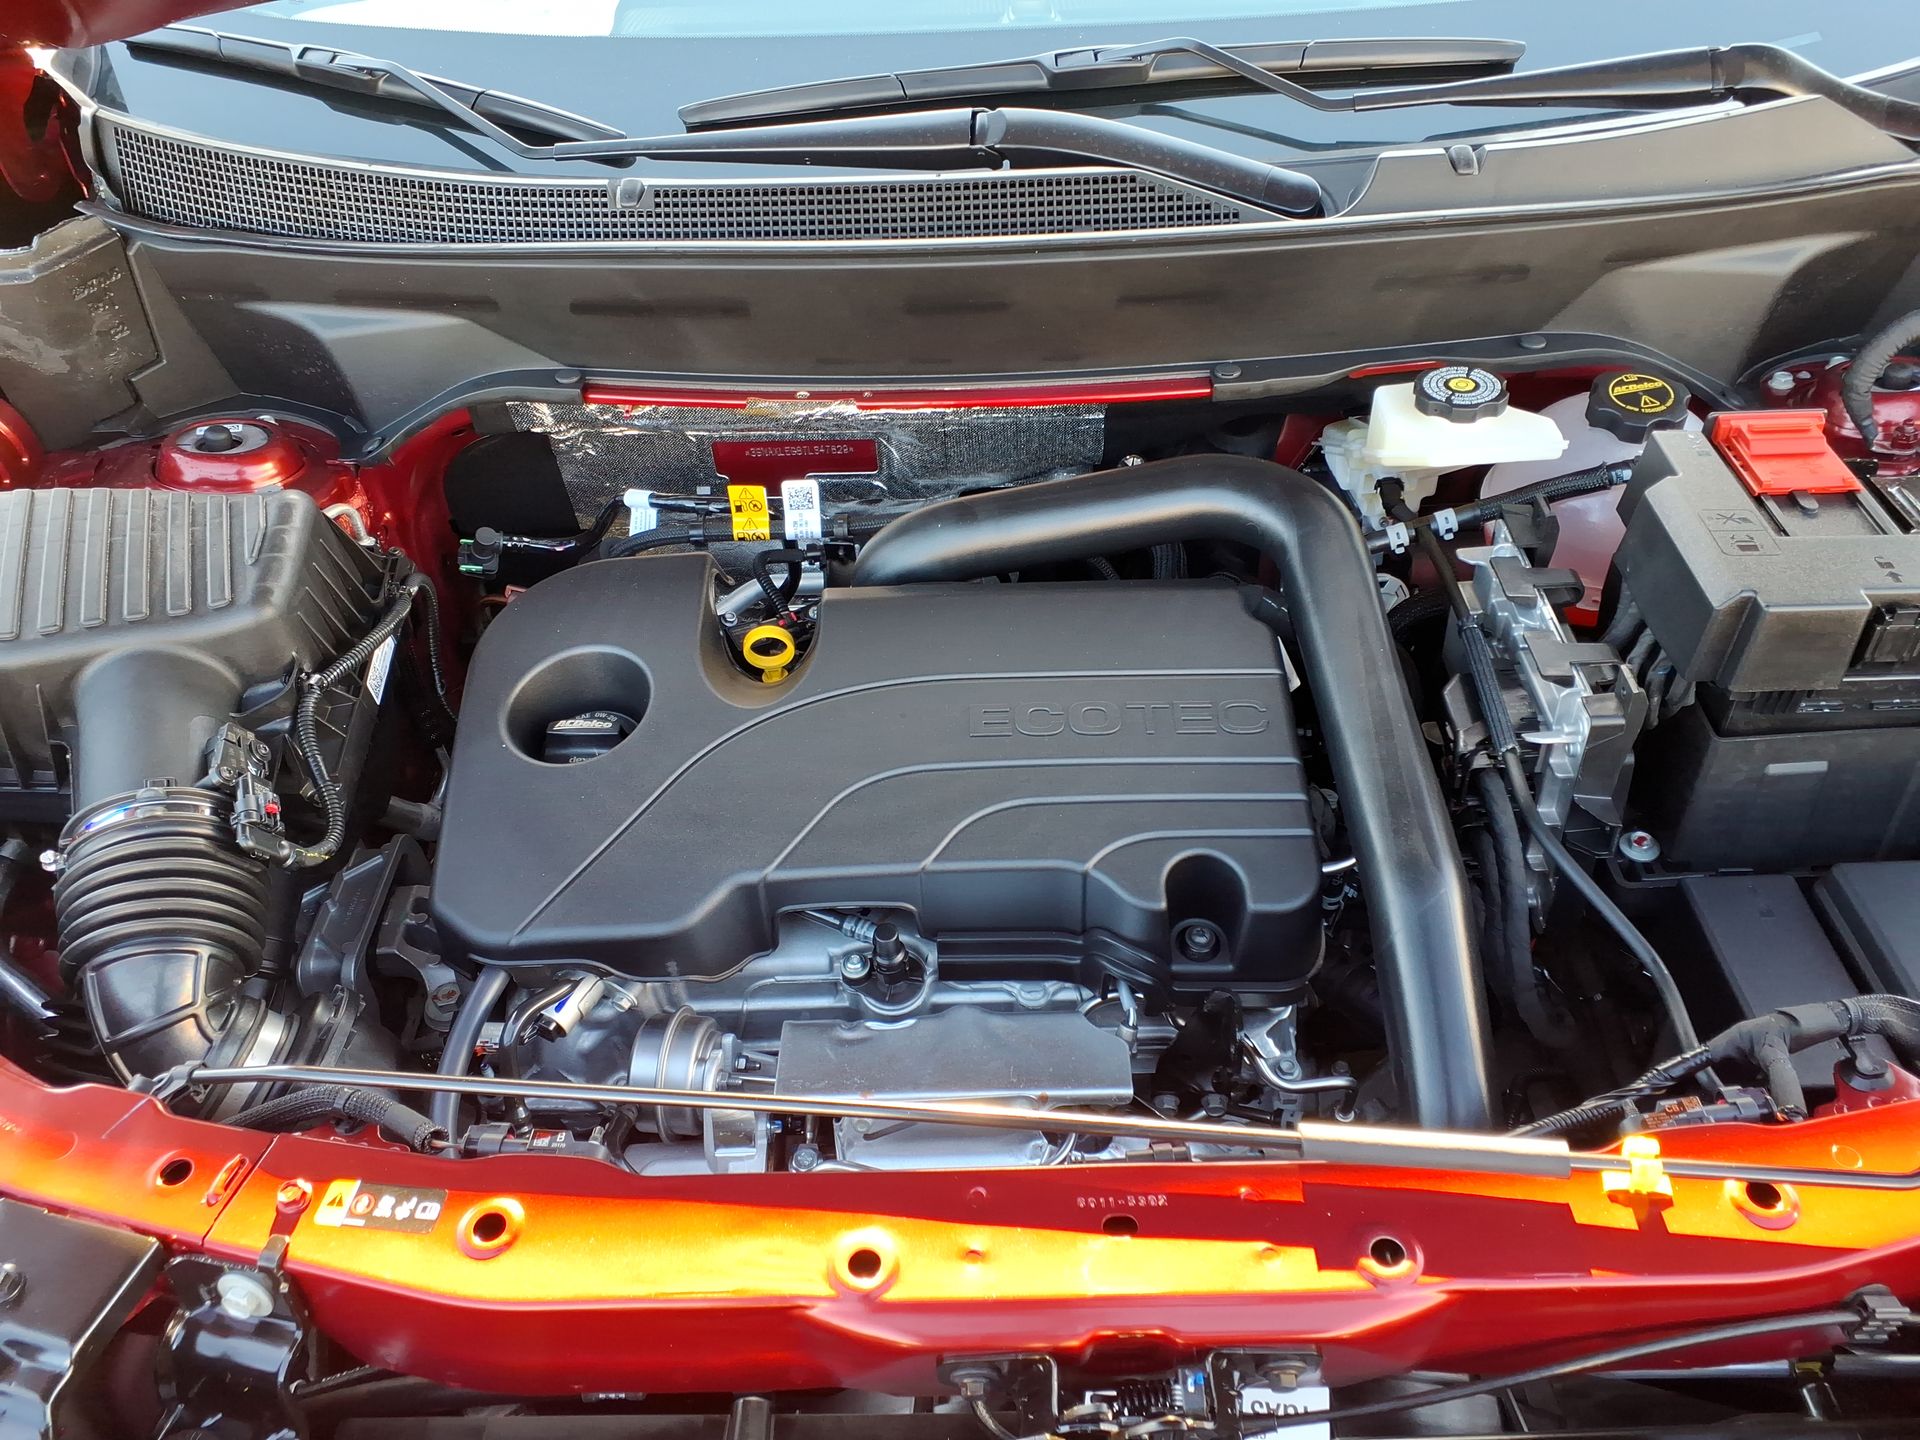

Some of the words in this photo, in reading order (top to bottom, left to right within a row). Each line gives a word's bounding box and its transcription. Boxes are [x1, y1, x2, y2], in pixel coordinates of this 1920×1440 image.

[969, 700, 1269, 737] ECOTEC
[553, 719, 613, 730] ACDelco
[556, 1132, 566, 1142] B
